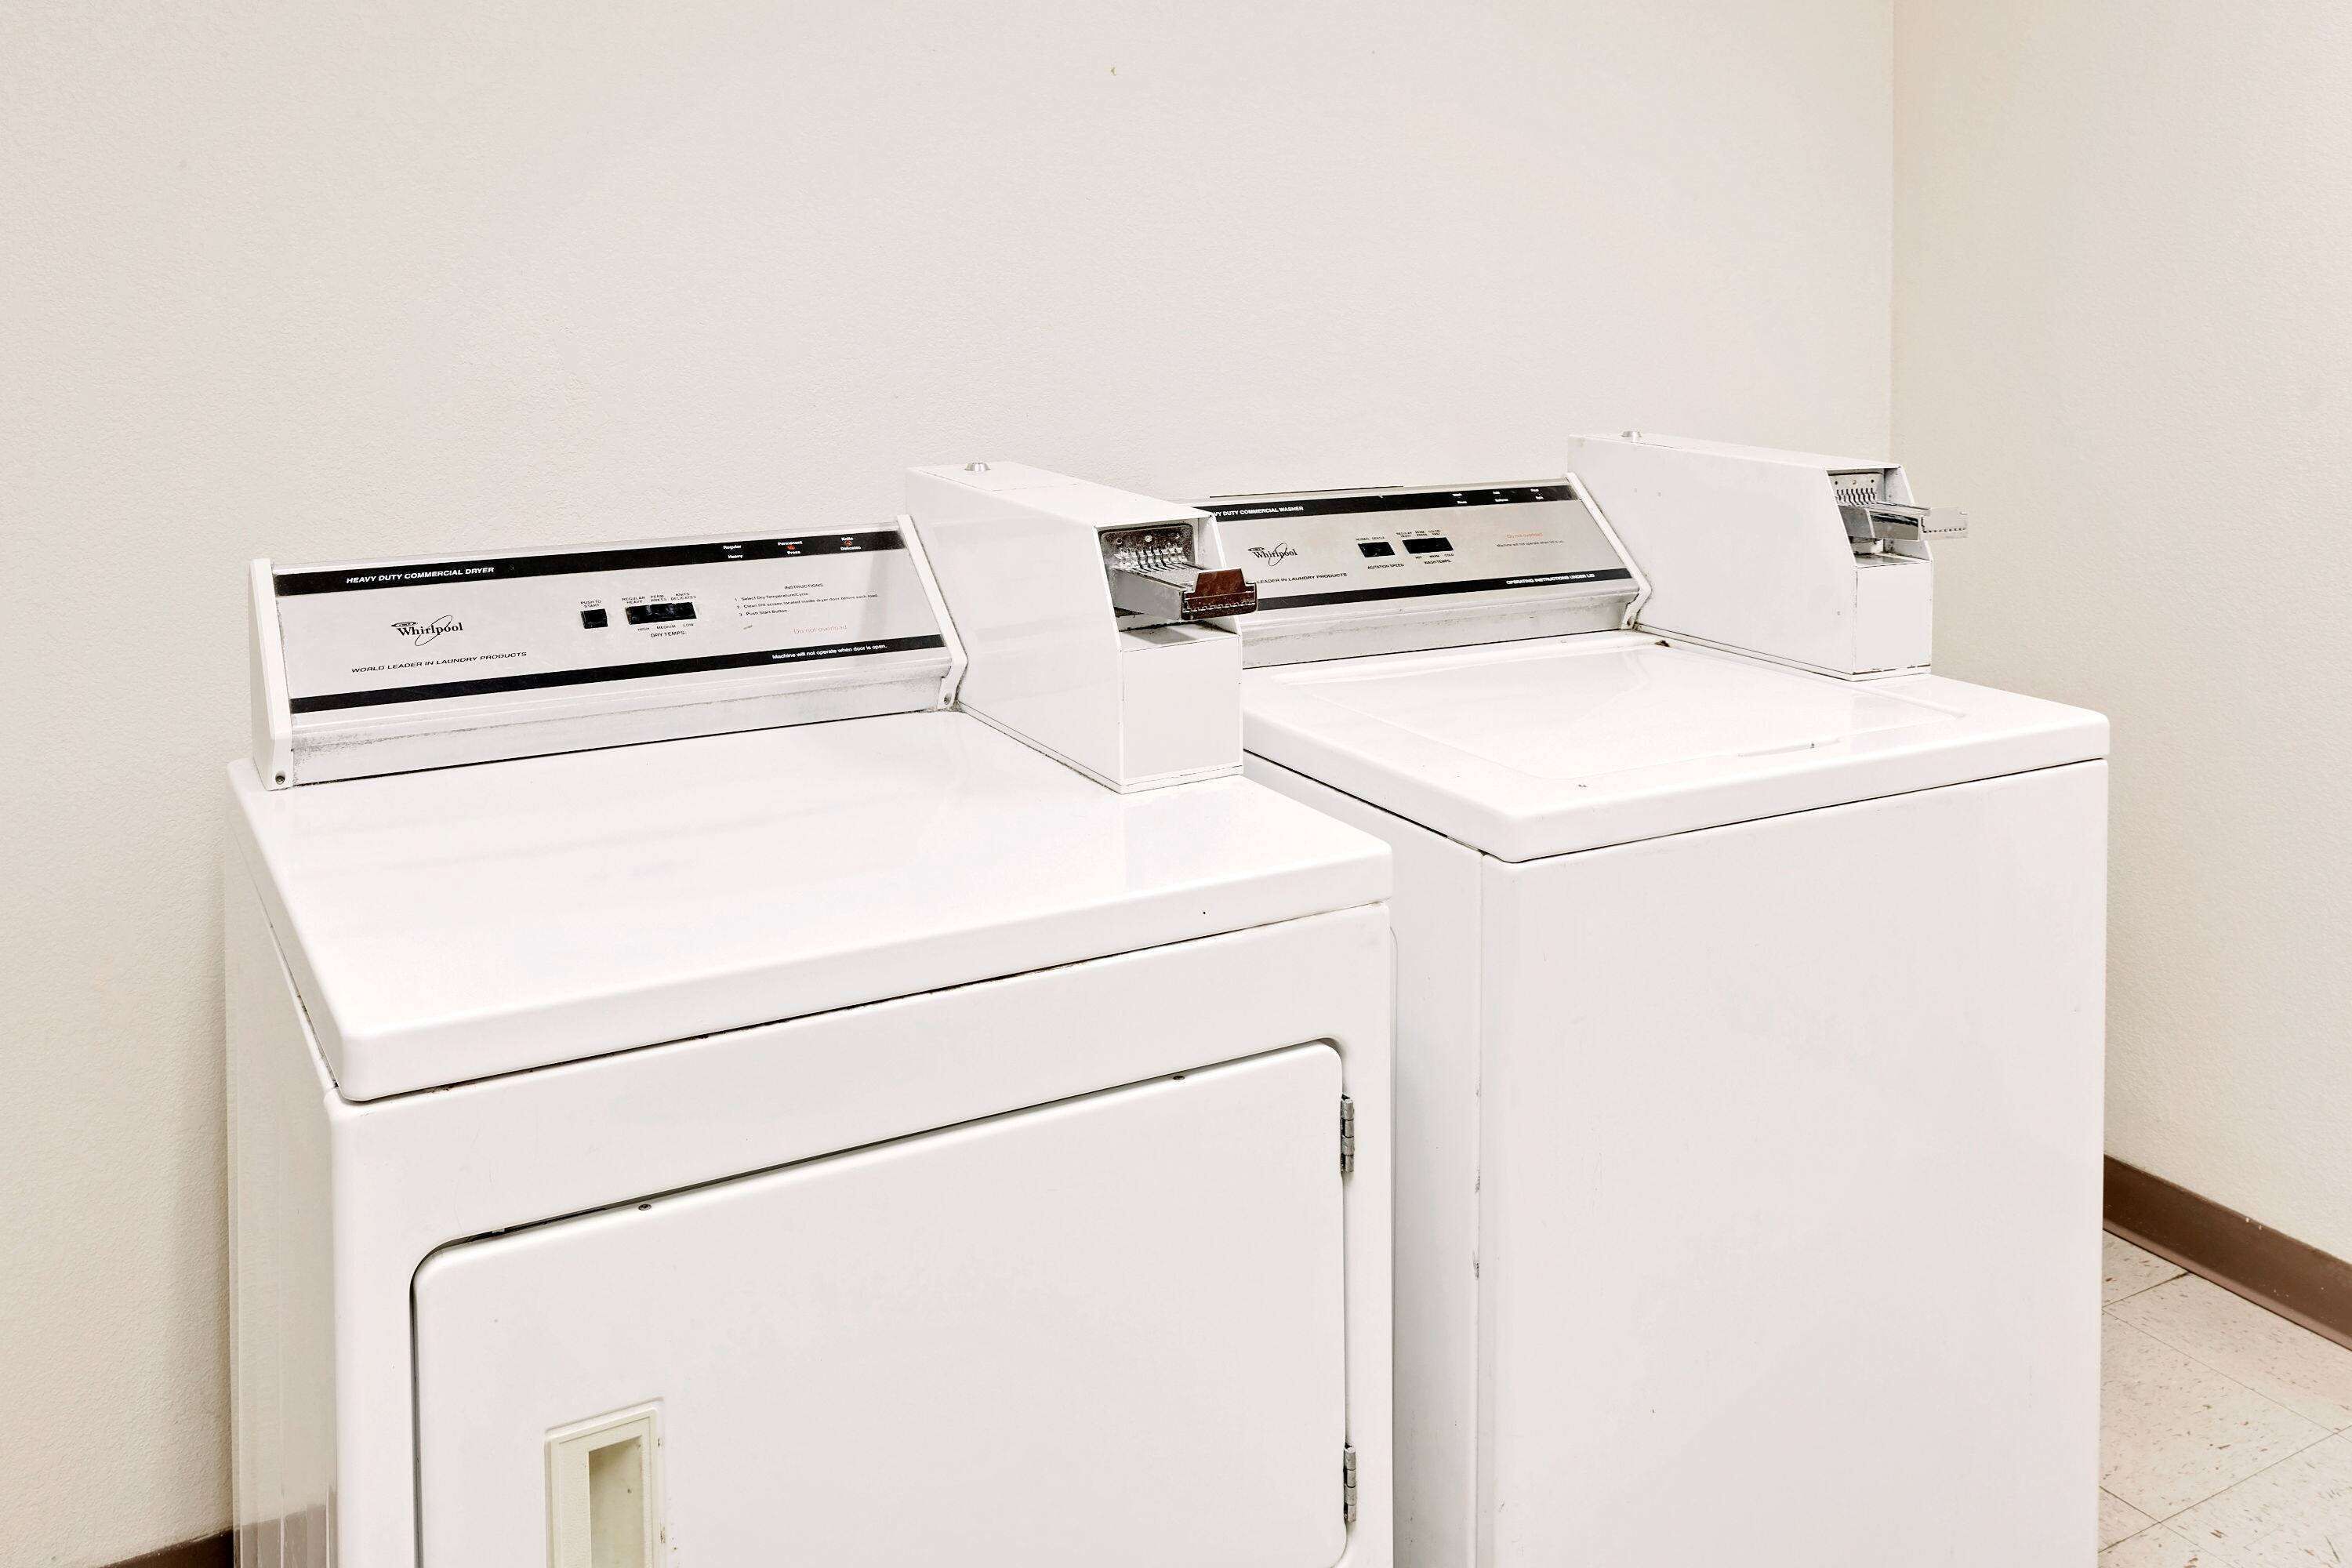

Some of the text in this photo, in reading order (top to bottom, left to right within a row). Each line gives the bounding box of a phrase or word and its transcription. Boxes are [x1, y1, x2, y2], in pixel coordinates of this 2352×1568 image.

[379, 573, 403, 582] DUTY
[405, 569, 463, 579] COMMERCIAL
[465, 566, 495, 575] DRYER
[397, 622, 463, 637] Whirlpool
[387, 661, 423, 670] LEADER
[436, 655, 477, 665] LAUNDRY
[480, 652, 528, 661] PRODUCTS
